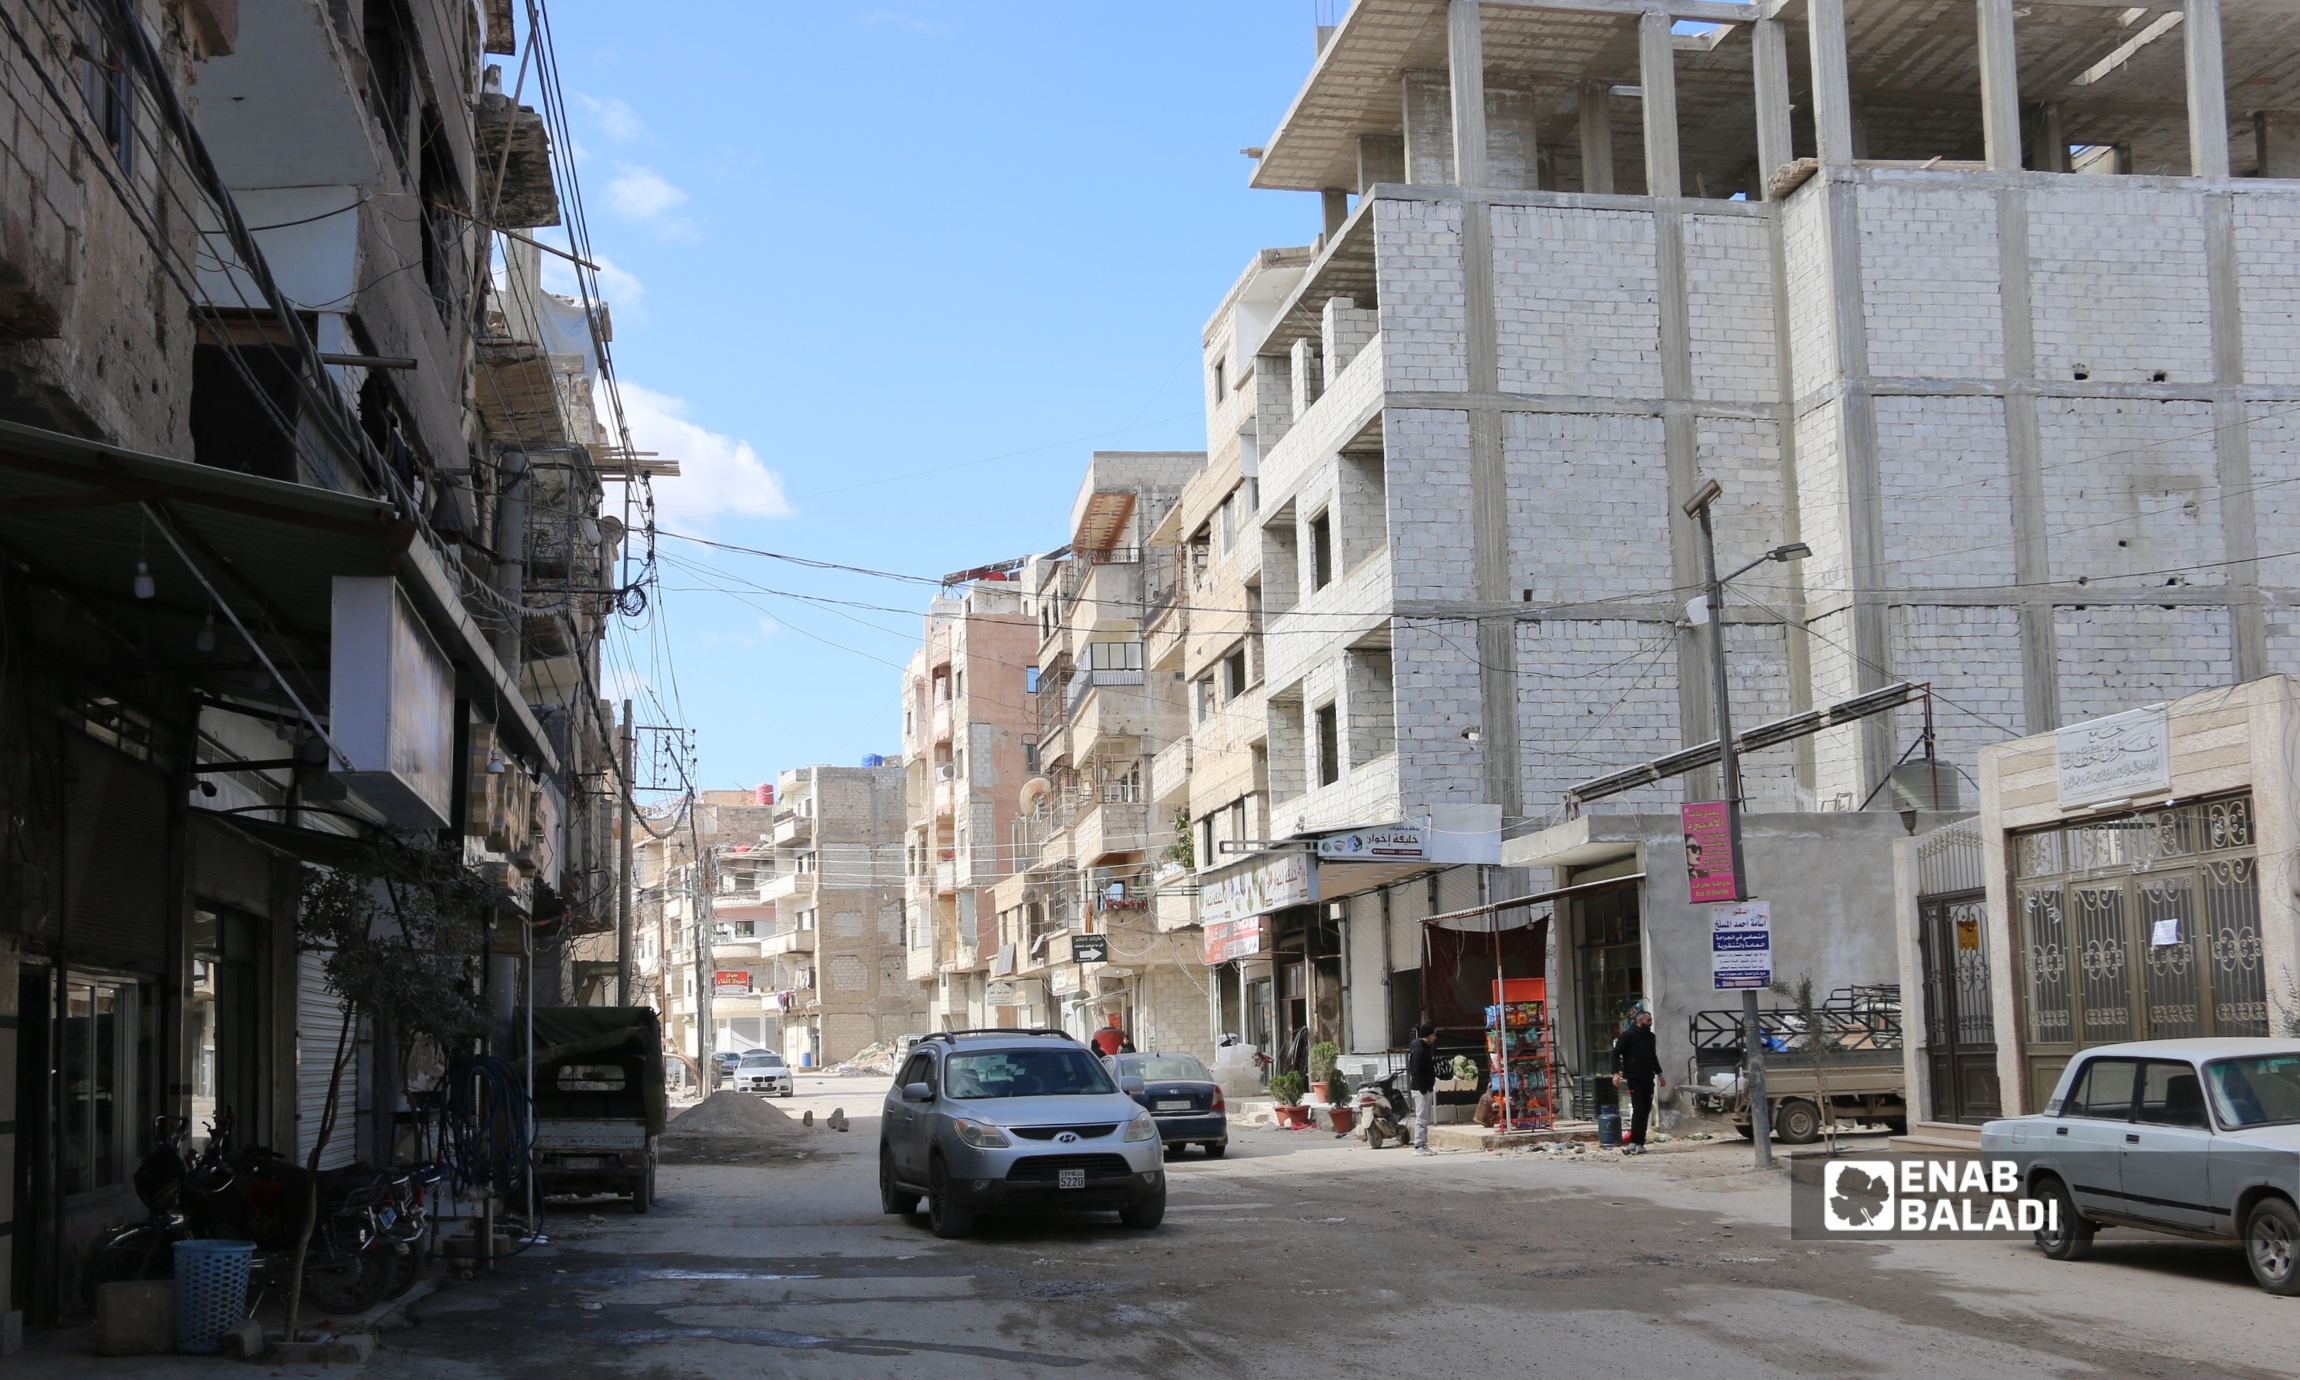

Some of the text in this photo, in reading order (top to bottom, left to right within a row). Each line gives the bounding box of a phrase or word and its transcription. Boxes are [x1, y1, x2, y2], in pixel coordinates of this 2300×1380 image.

[2088, 727, 2124, 743] جامع
[1367, 833, 1419, 846] خليفة إخوان
[1732, 908, 1750, 916] الدكتور
[1715, 934, 1735, 942] الجراحة
[1061, 1177, 1083, 1187] 5220
